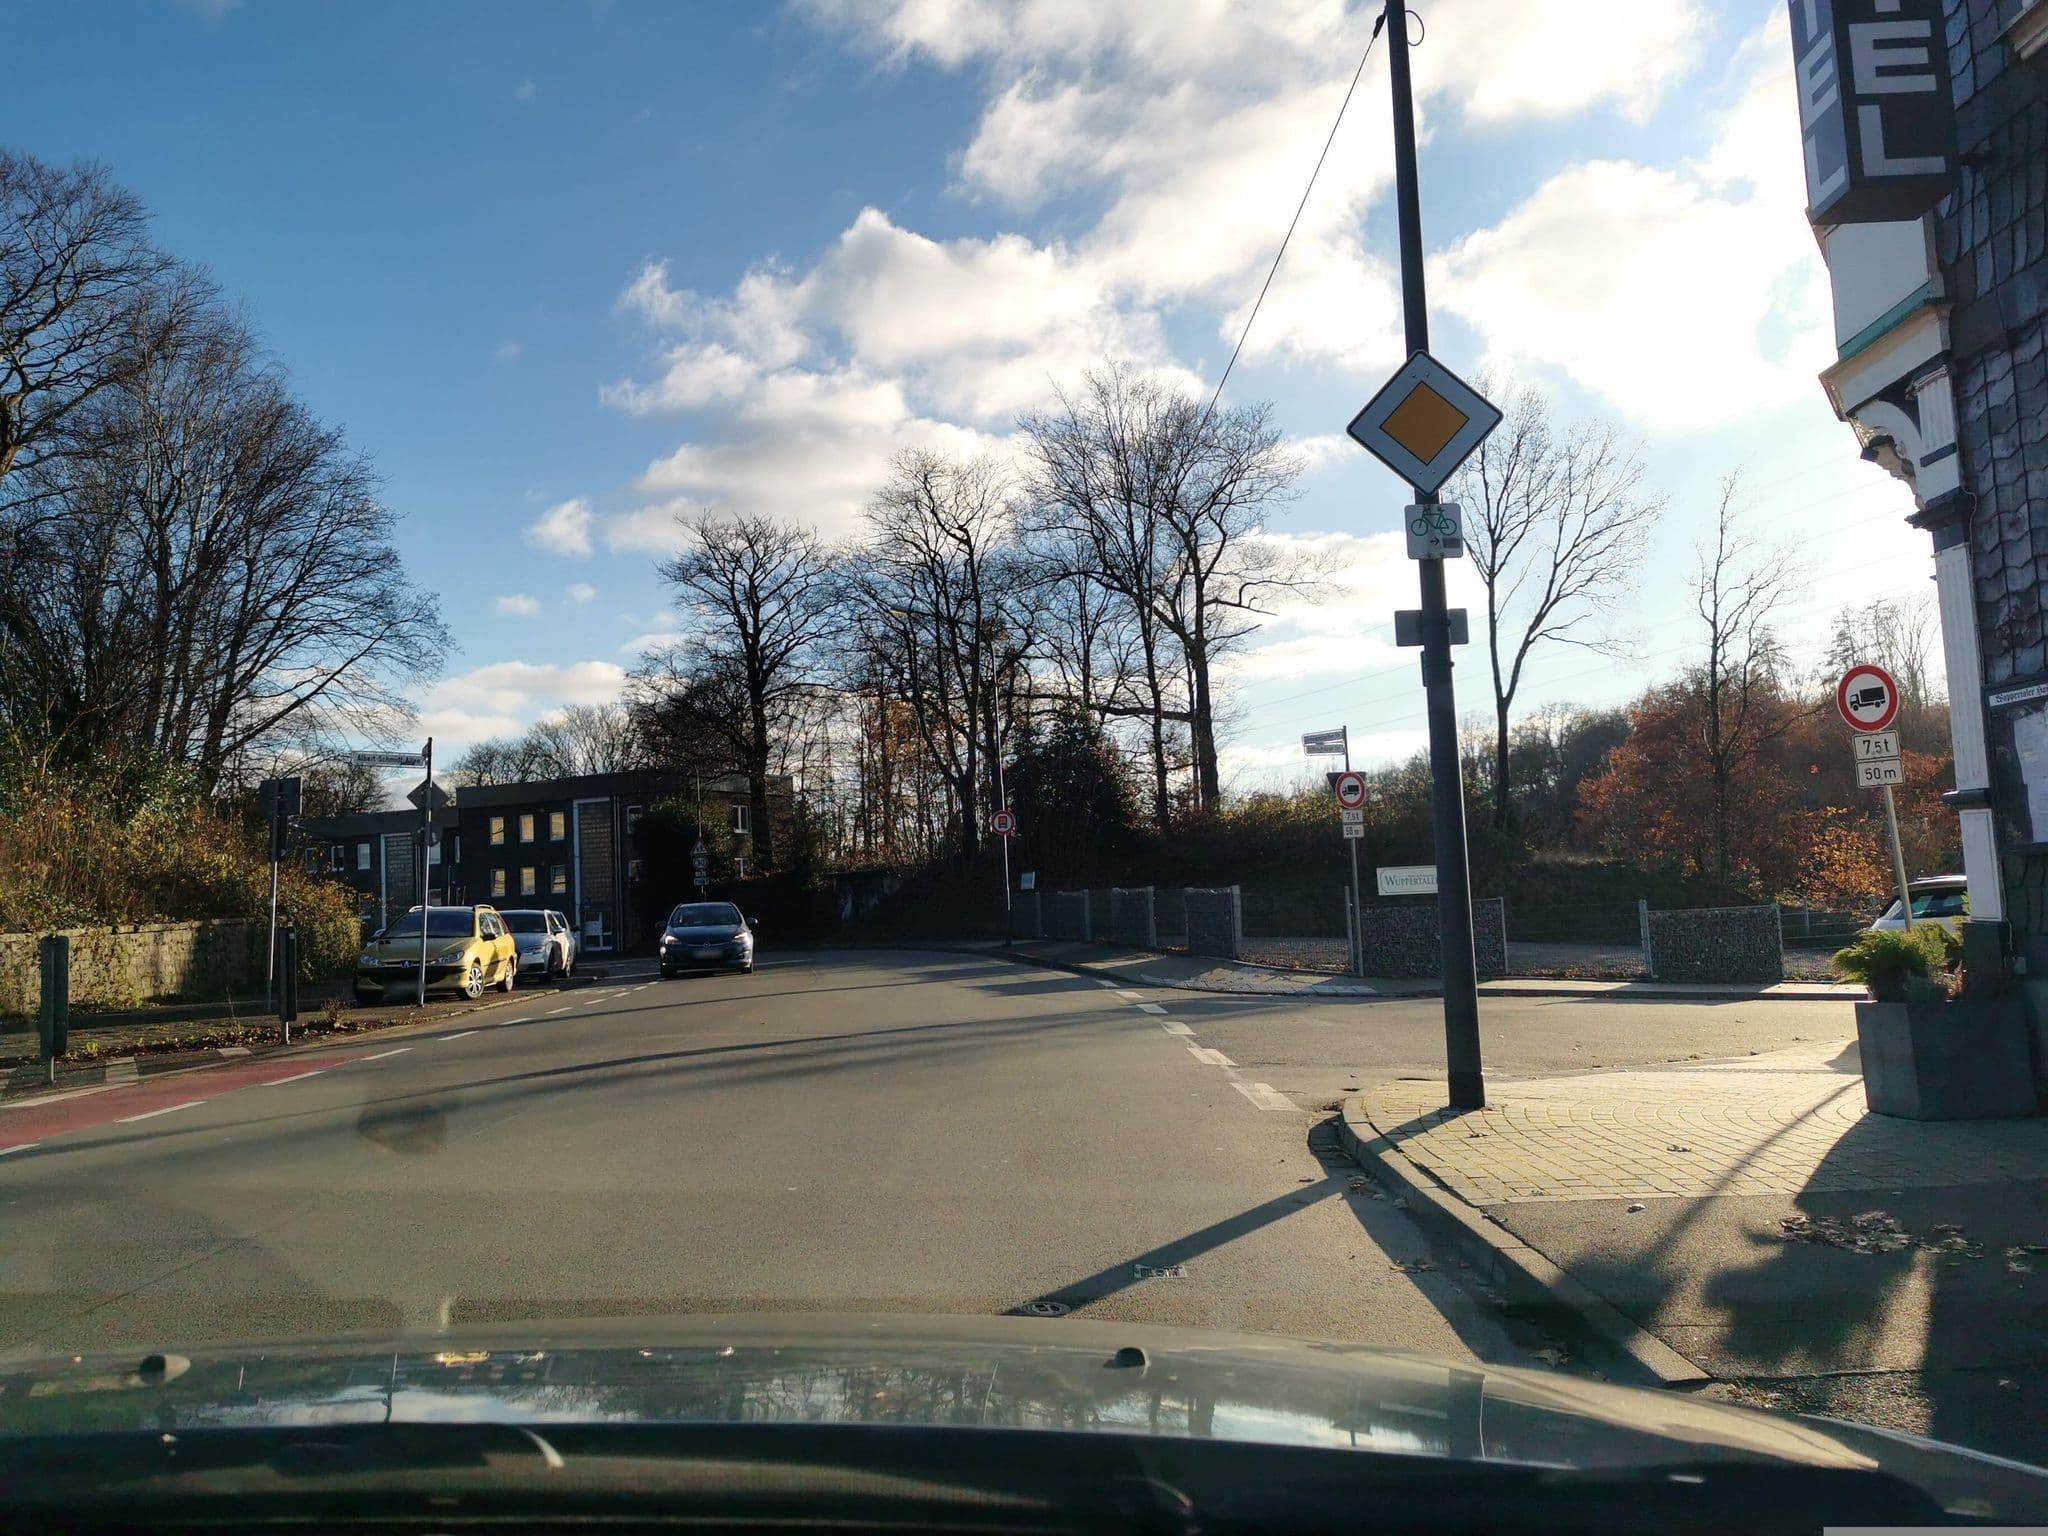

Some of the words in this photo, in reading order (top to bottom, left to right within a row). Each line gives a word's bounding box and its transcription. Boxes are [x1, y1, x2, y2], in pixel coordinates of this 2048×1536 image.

[1849, 0, 1946, 177] EL
[1865, 768, 1881, 780] 50
[1884, 769, 1897, 778] m
[1384, 874, 1438, 888] WUPPERTALE
